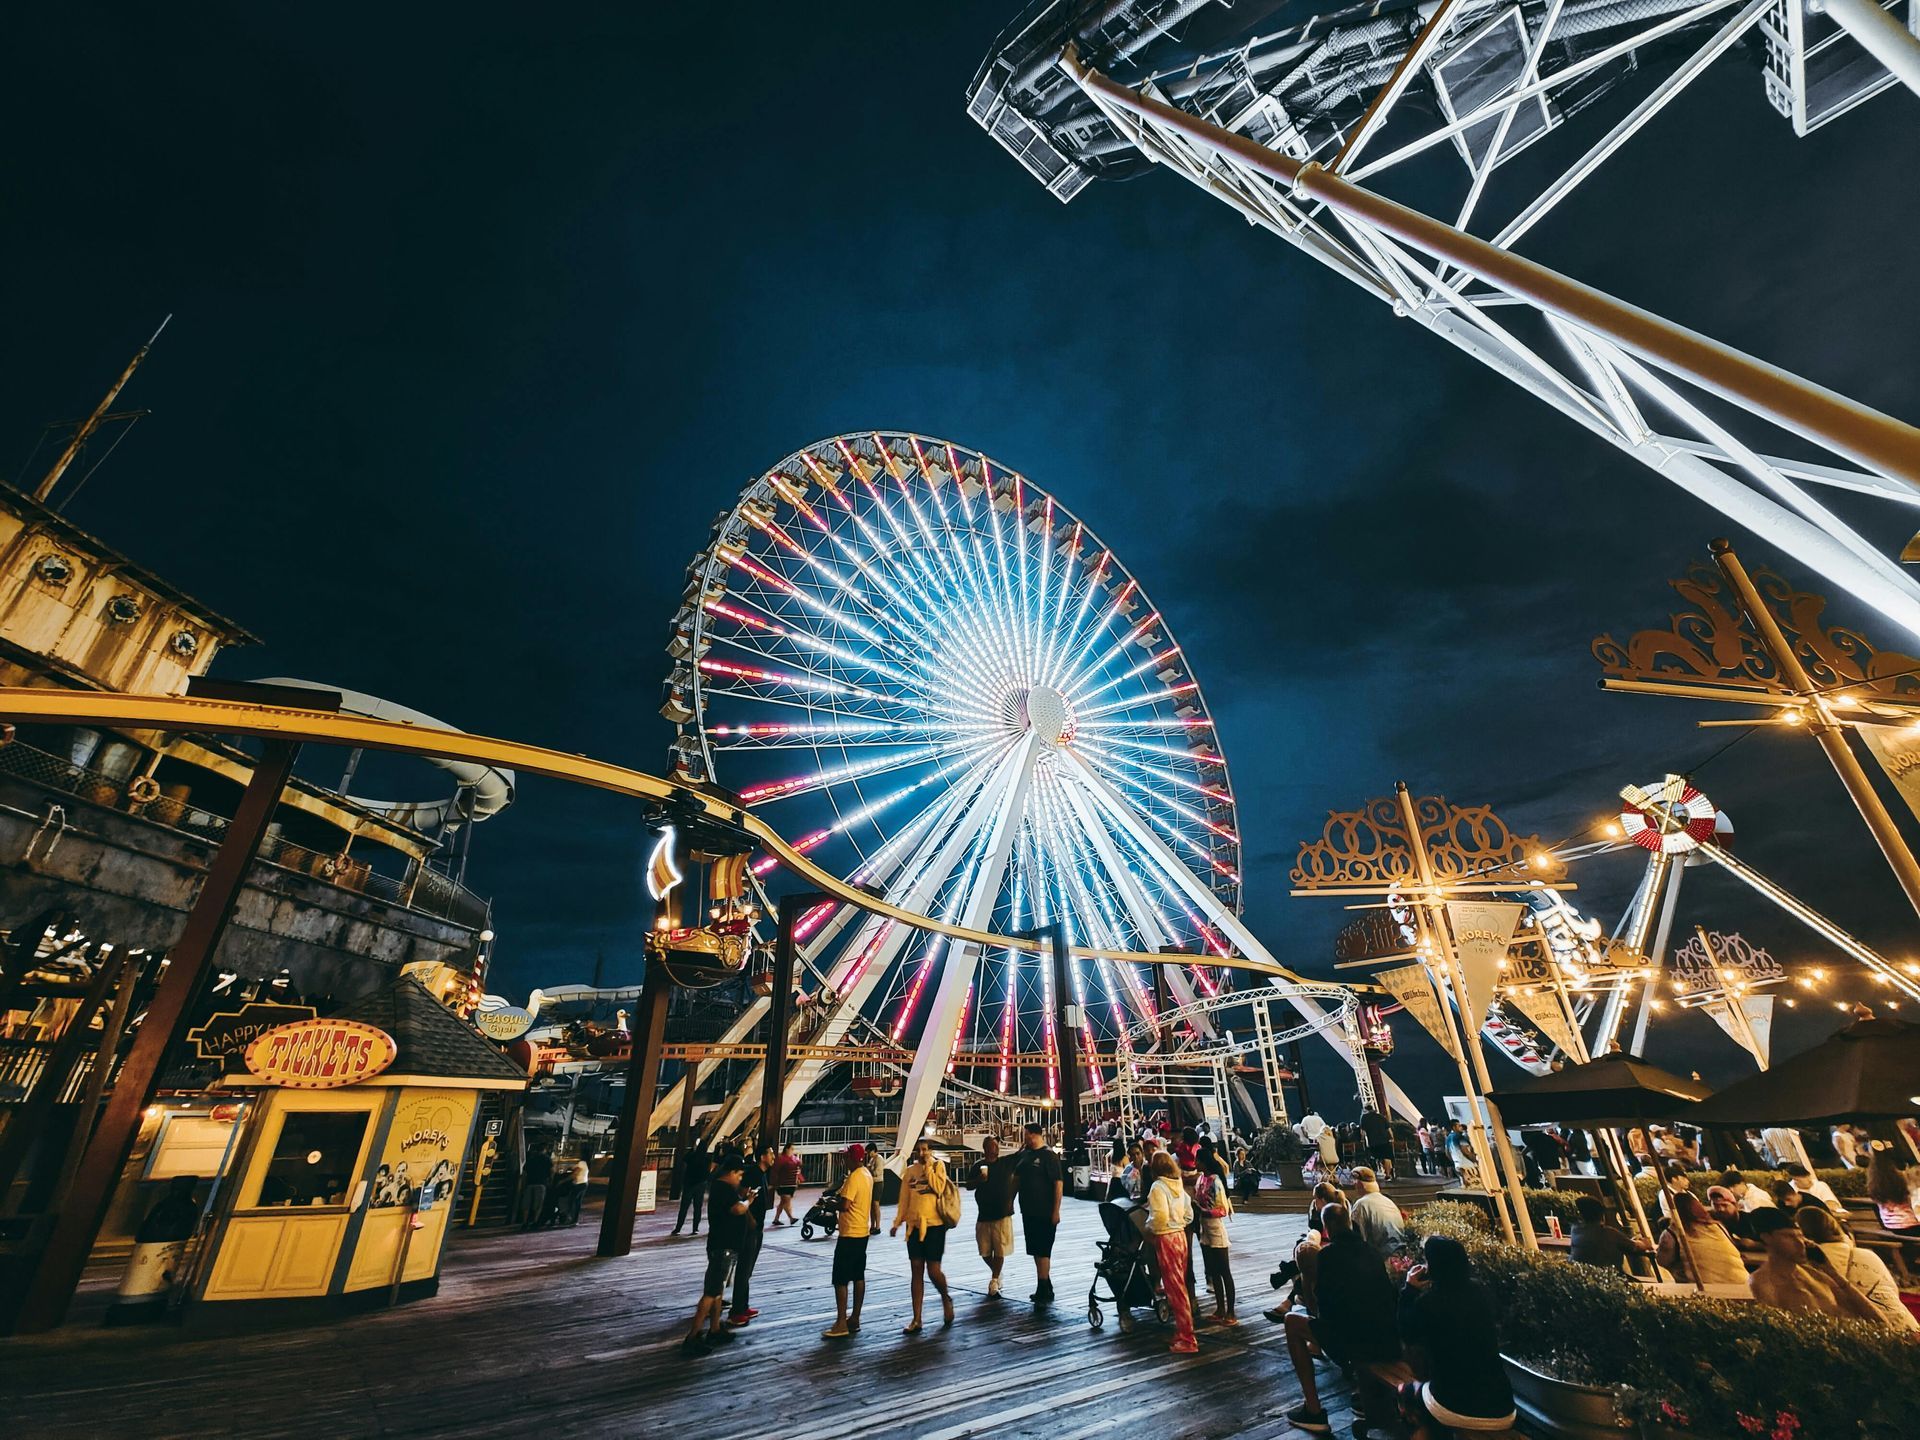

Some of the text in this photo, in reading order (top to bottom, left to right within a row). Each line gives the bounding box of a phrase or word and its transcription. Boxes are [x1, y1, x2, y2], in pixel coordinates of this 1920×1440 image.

[1458, 929, 1507, 947] MOREY'S
[479, 1012, 530, 1025] SEAGULL
[204, 1023, 265, 1054] HAPPY
[266, 1028, 374, 1078] TICKETS
[490, 1122, 498, 1131] 5
[400, 1128, 450, 1152] MOREY'S
